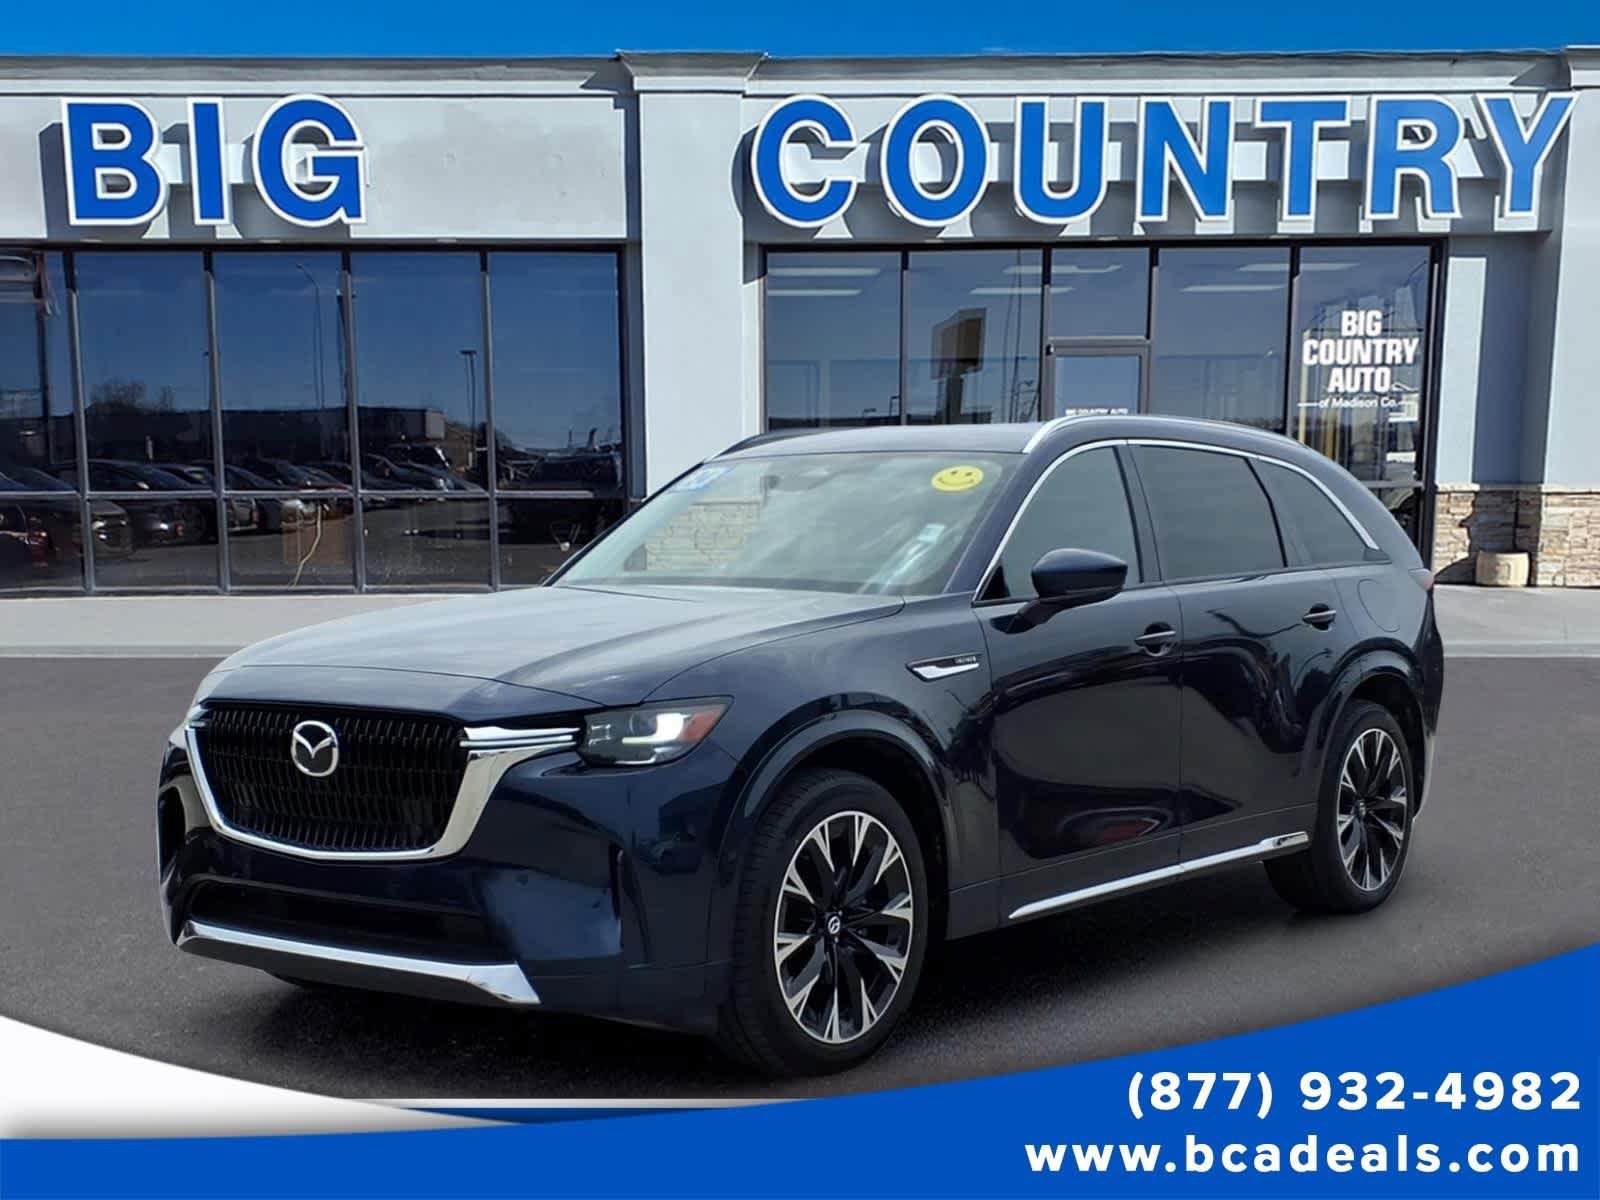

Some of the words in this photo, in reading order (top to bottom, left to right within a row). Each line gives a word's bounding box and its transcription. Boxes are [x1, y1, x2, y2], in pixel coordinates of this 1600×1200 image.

[61, 94, 366, 227] BIG
[751, 92, 1577, 228] COUNTRY
[1341, 309, 1382, 337] BIG
[1303, 337, 1420, 366] COUNTRY
[1327, 366, 1392, 393] AUTO
[1319, 398, 1329, 408] of
[1331, 398, 1378, 408] Madison
